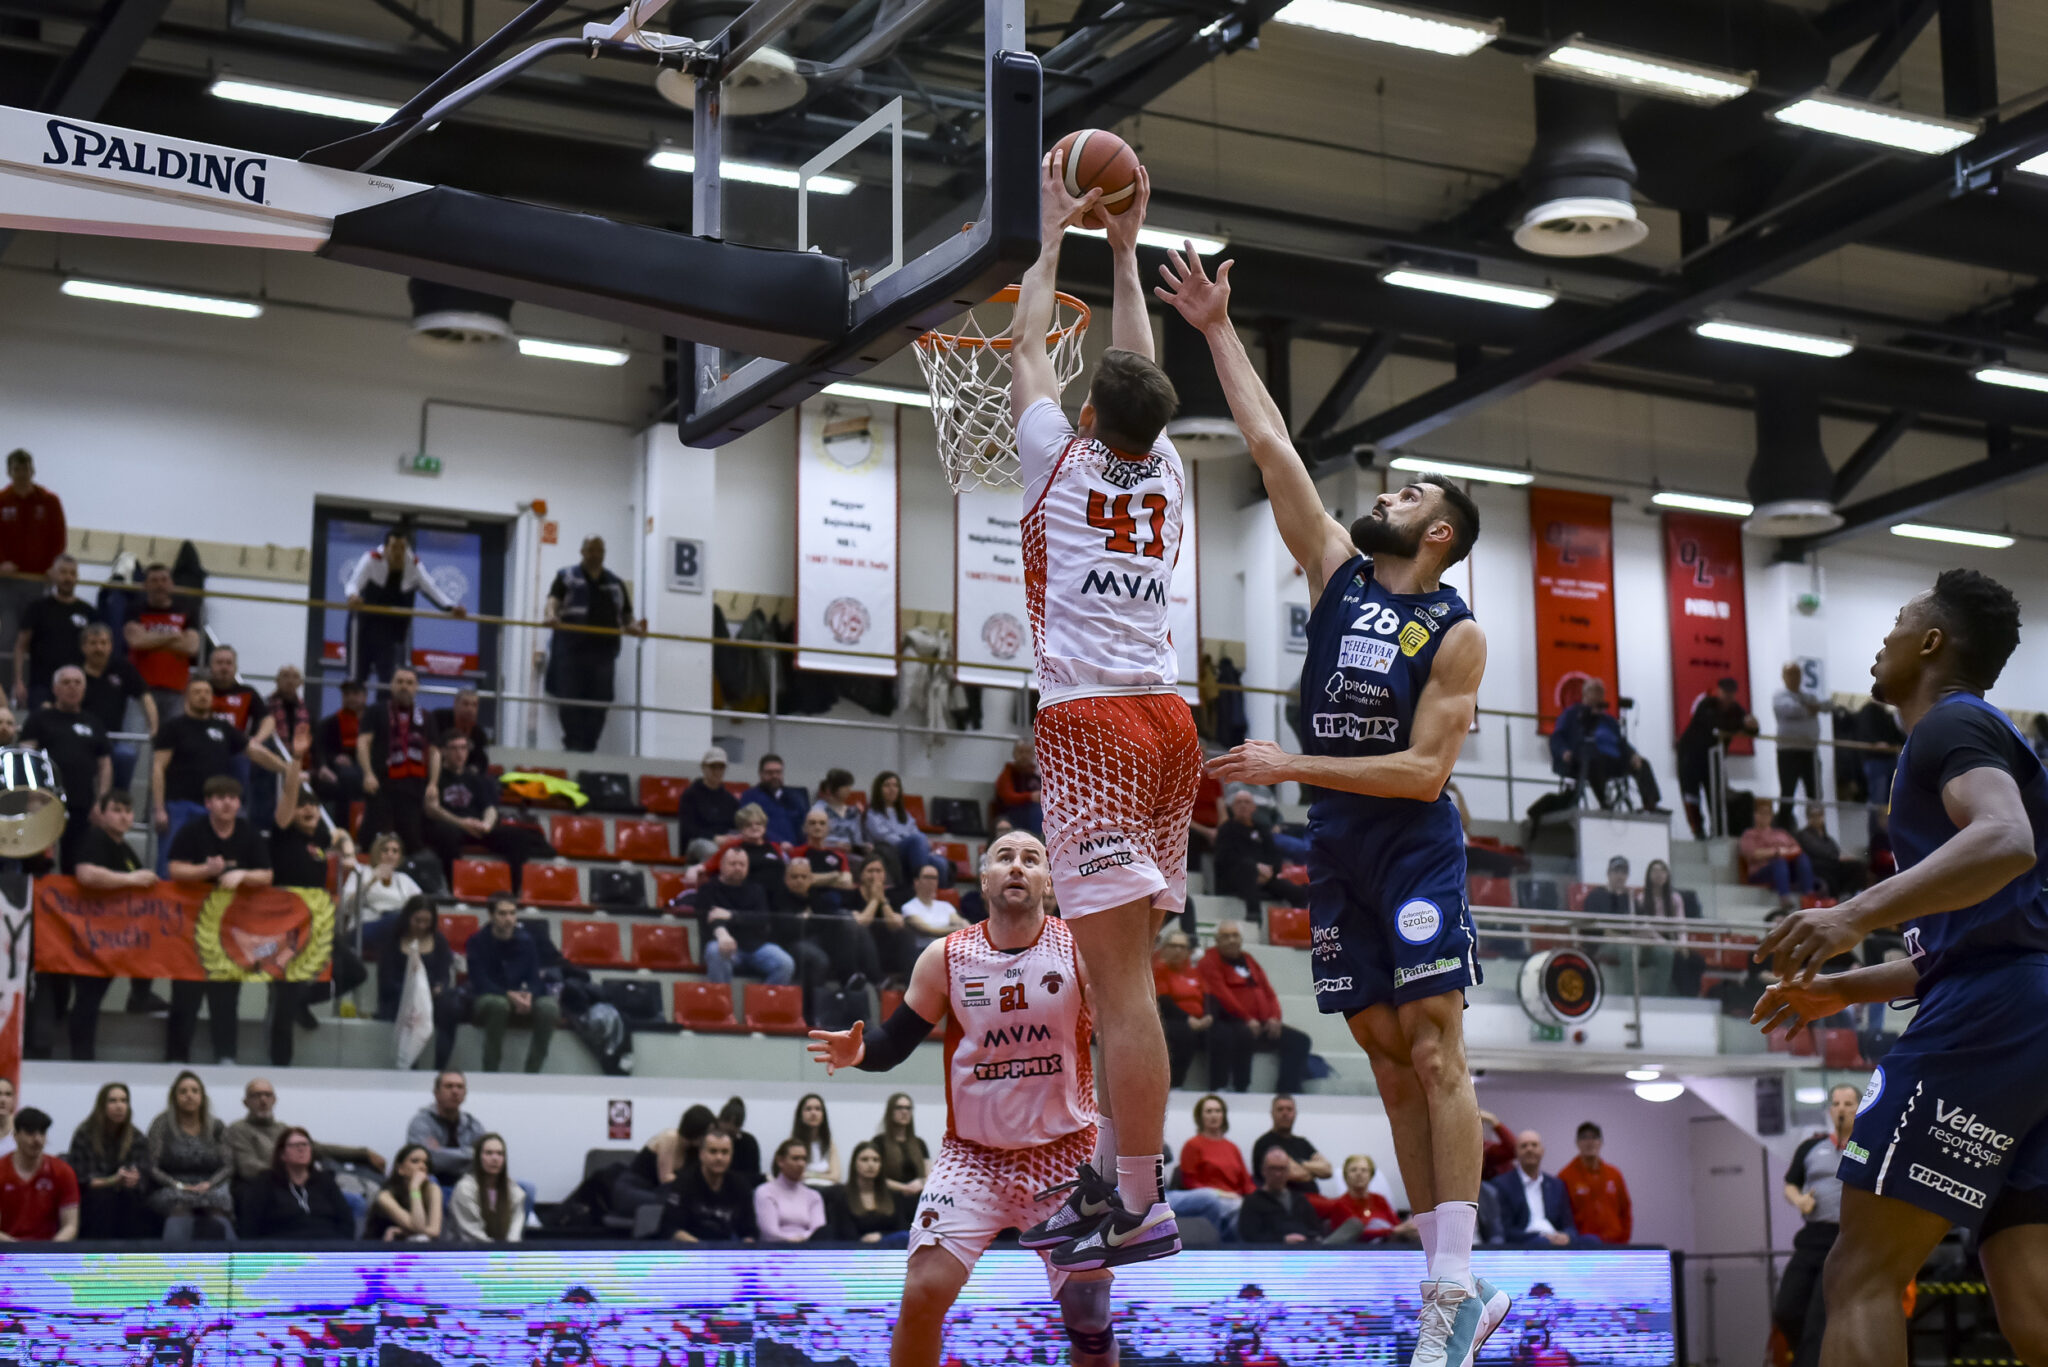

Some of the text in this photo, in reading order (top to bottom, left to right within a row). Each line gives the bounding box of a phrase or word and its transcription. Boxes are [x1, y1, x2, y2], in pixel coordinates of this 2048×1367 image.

[43, 119, 267, 204] SPALDING
[1087, 488, 1168, 561] 41
[675, 542, 698, 577] B
[1081, 570, 1166, 607] MVM
[1350, 602, 1400, 635] 28
[1341, 652, 1373, 668] TAVEL
[1080, 835, 1124, 855] MVM
[999, 983, 1029, 1013] 21
[984, 1024, 1051, 1048] MVM
[1936, 1098, 2014, 1151] Velence
[1927, 1125, 2002, 1167] resort&spa
